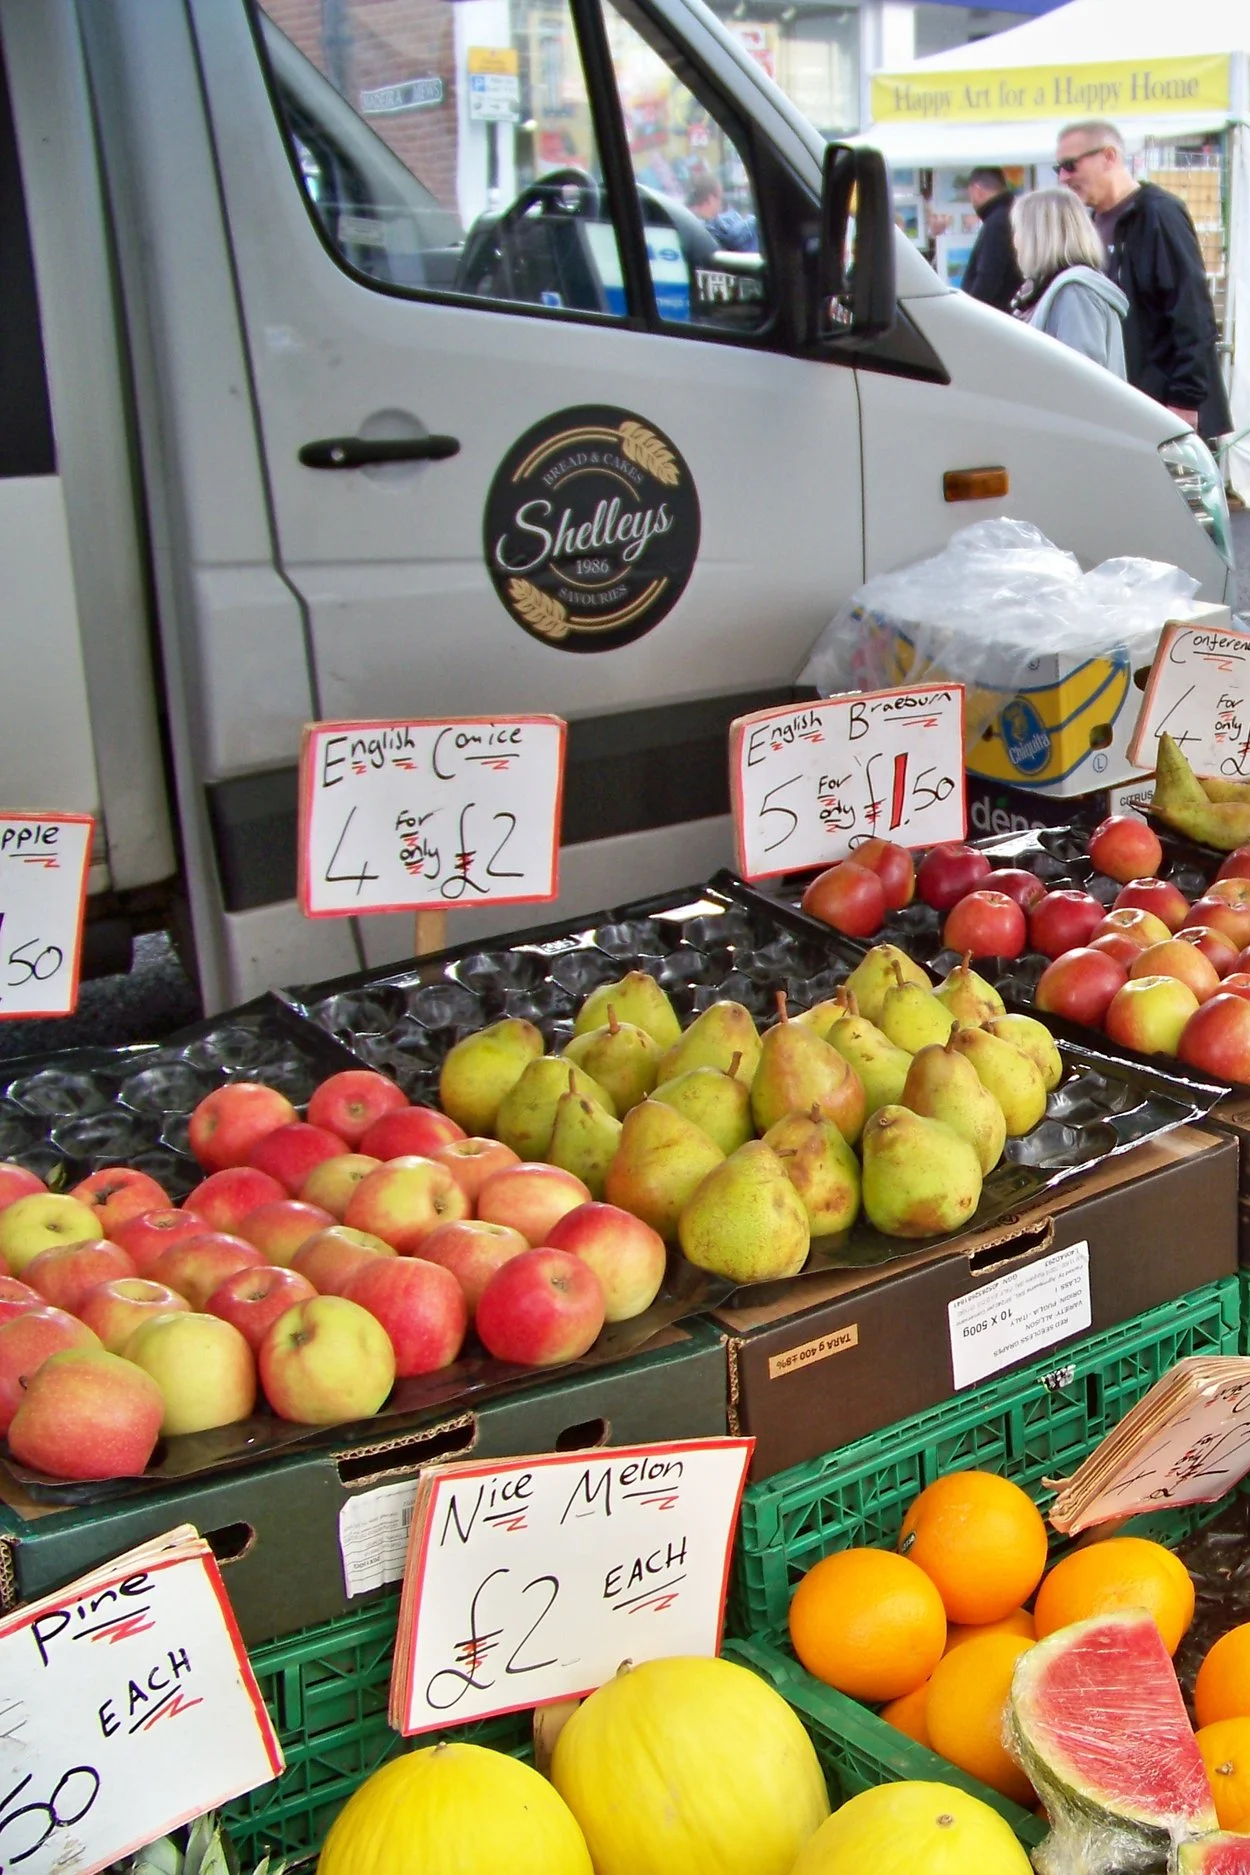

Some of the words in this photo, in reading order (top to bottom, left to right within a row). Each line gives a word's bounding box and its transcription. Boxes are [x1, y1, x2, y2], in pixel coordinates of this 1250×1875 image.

[892, 86, 951, 117] Happy
[963, 84, 991, 109] Art
[999, 81, 1025, 107] for
[1033, 87, 1046, 106] a
[1054, 77, 1124, 113] Happy
[1130, 72, 1199, 103] Home
[542, 453, 588, 487] BREAD
[589, 452, 600, 463] &
[603, 453, 645, 485] CAKES
[496, 496, 674, 571] Shelleys
[576, 559, 610, 576] 1986
[557, 584, 629, 606] SAVOURIES
[748, 710, 823, 767] English
[849, 692, 952, 741] Braeburn
[1154, 685, 1202, 751] 4
[1214, 719, 1242, 741] only
[323, 727, 416, 788] English
[1008, 732, 1051, 765] Chiquita
[759, 775, 804, 852] 5
[848, 752, 955, 850] £1.50
[1119, 789, 1154, 807] CITRUS
[325, 806, 380, 896] 4
[399, 838, 441, 880] only
[439, 803, 525, 900] £2
[963, 1320, 988, 1338] 500g
[1000, 1308, 1013, 1321] 10
[799, 1348, 818, 1361] 400
[826, 1333, 852, 1350] TARA
[439, 1473, 535, 1547] Nice
[560, 1457, 684, 1525] Melon
[425, 1568, 560, 1710] £2
[602, 1535, 688, 1599] EACH
[98, 1647, 192, 1739] EACH
